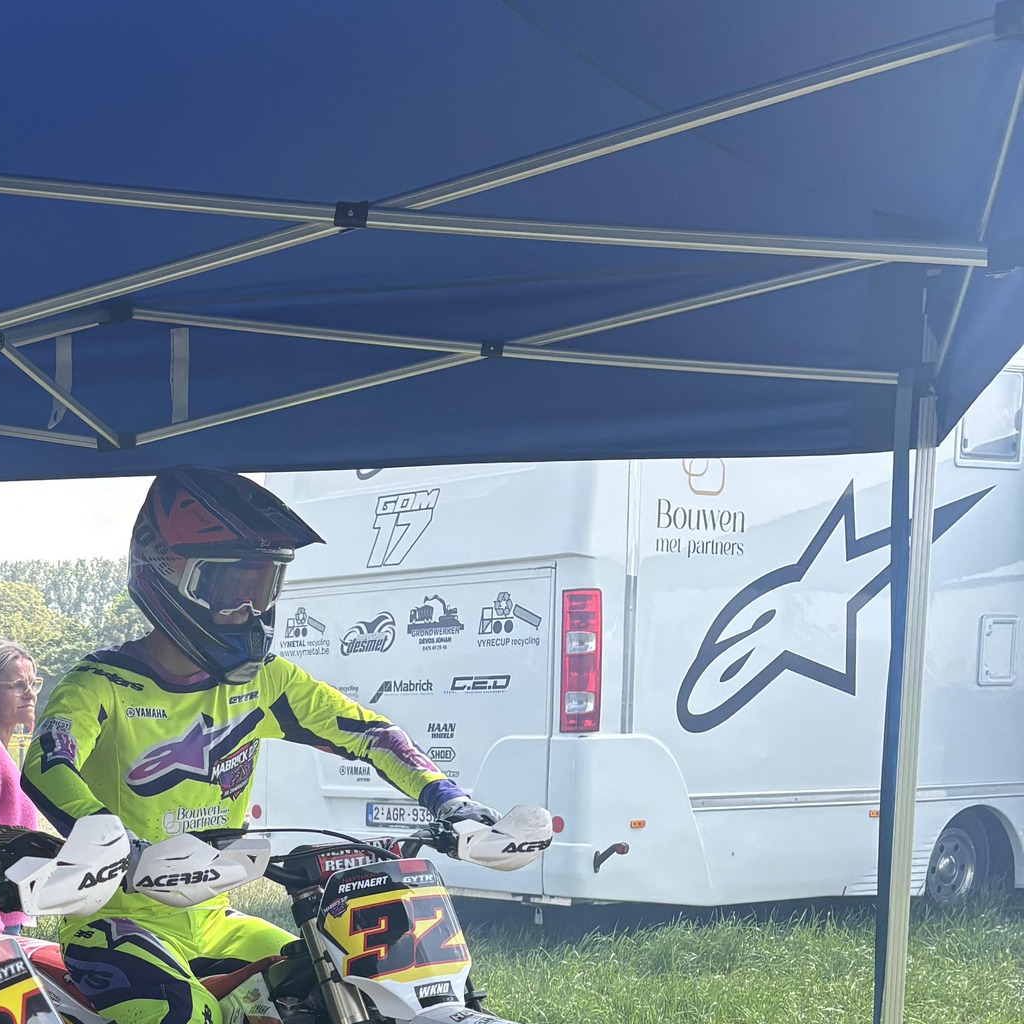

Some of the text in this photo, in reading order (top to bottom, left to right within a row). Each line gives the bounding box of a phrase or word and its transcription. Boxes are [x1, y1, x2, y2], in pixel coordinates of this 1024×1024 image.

[656, 498, 746, 533] Bouwen
[366, 510, 434, 569] 17
[655, 536, 746, 558] met partners
[410, 626, 461, 638] GRONDWERKEN
[279, 638, 330, 648] VYMETAL recycling
[346, 634, 389, 654] desmet
[477, 636, 541, 648] VYRECUP recycling
[392, 679, 434, 693] Mabrick
[228, 690, 260, 705] GYTR
[135, 706, 168, 719] YAMAHA
[427, 722, 456, 733] HAAN
[430, 748, 453, 761] SHOEI
[210, 748, 249, 782] MABRICK
[346, 766, 371, 776] YAMAHA
[176, 805, 222, 821] Bouwen
[181, 813, 229, 832] partners
[135, 868, 221, 888] ACERBIS
[338, 875, 389, 894] REYNAERT
[342, 894, 469, 980] 32
